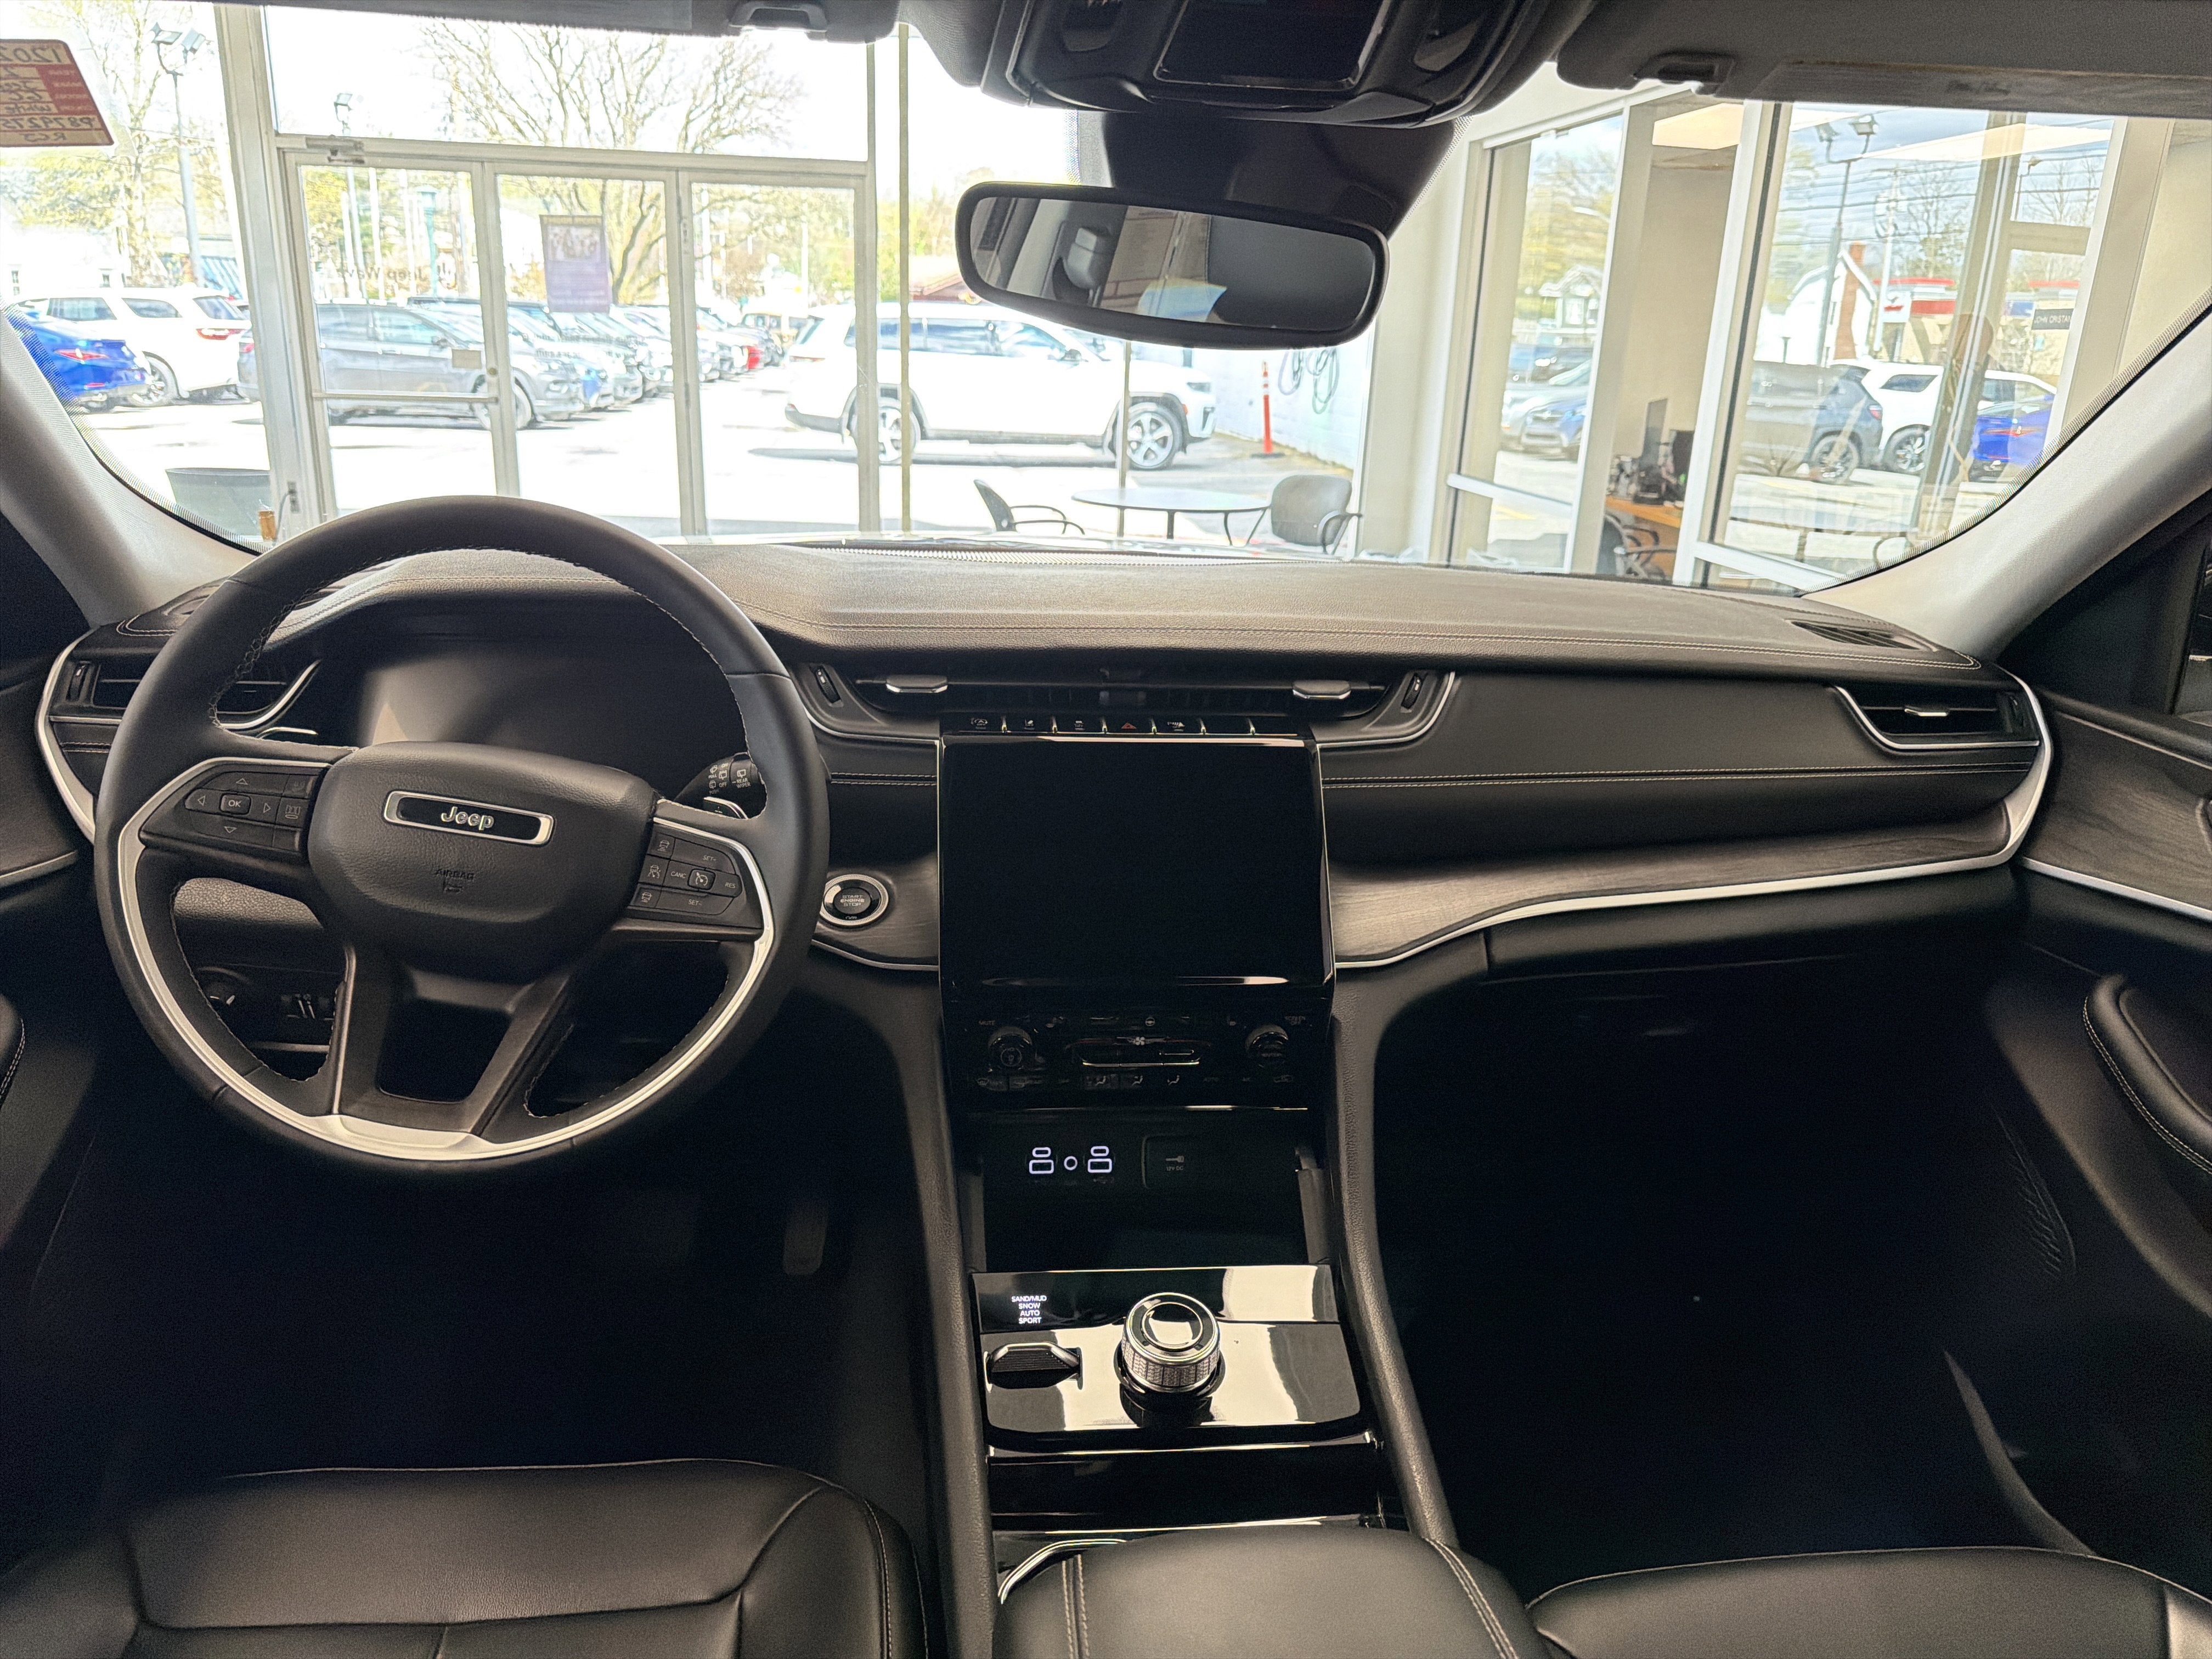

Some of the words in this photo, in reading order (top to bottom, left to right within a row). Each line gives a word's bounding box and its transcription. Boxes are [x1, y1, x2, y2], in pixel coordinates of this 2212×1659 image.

[228, 799, 242, 808] OK
[441, 805, 495, 831] Jeep
[435, 868, 475, 881] AIRBAG
